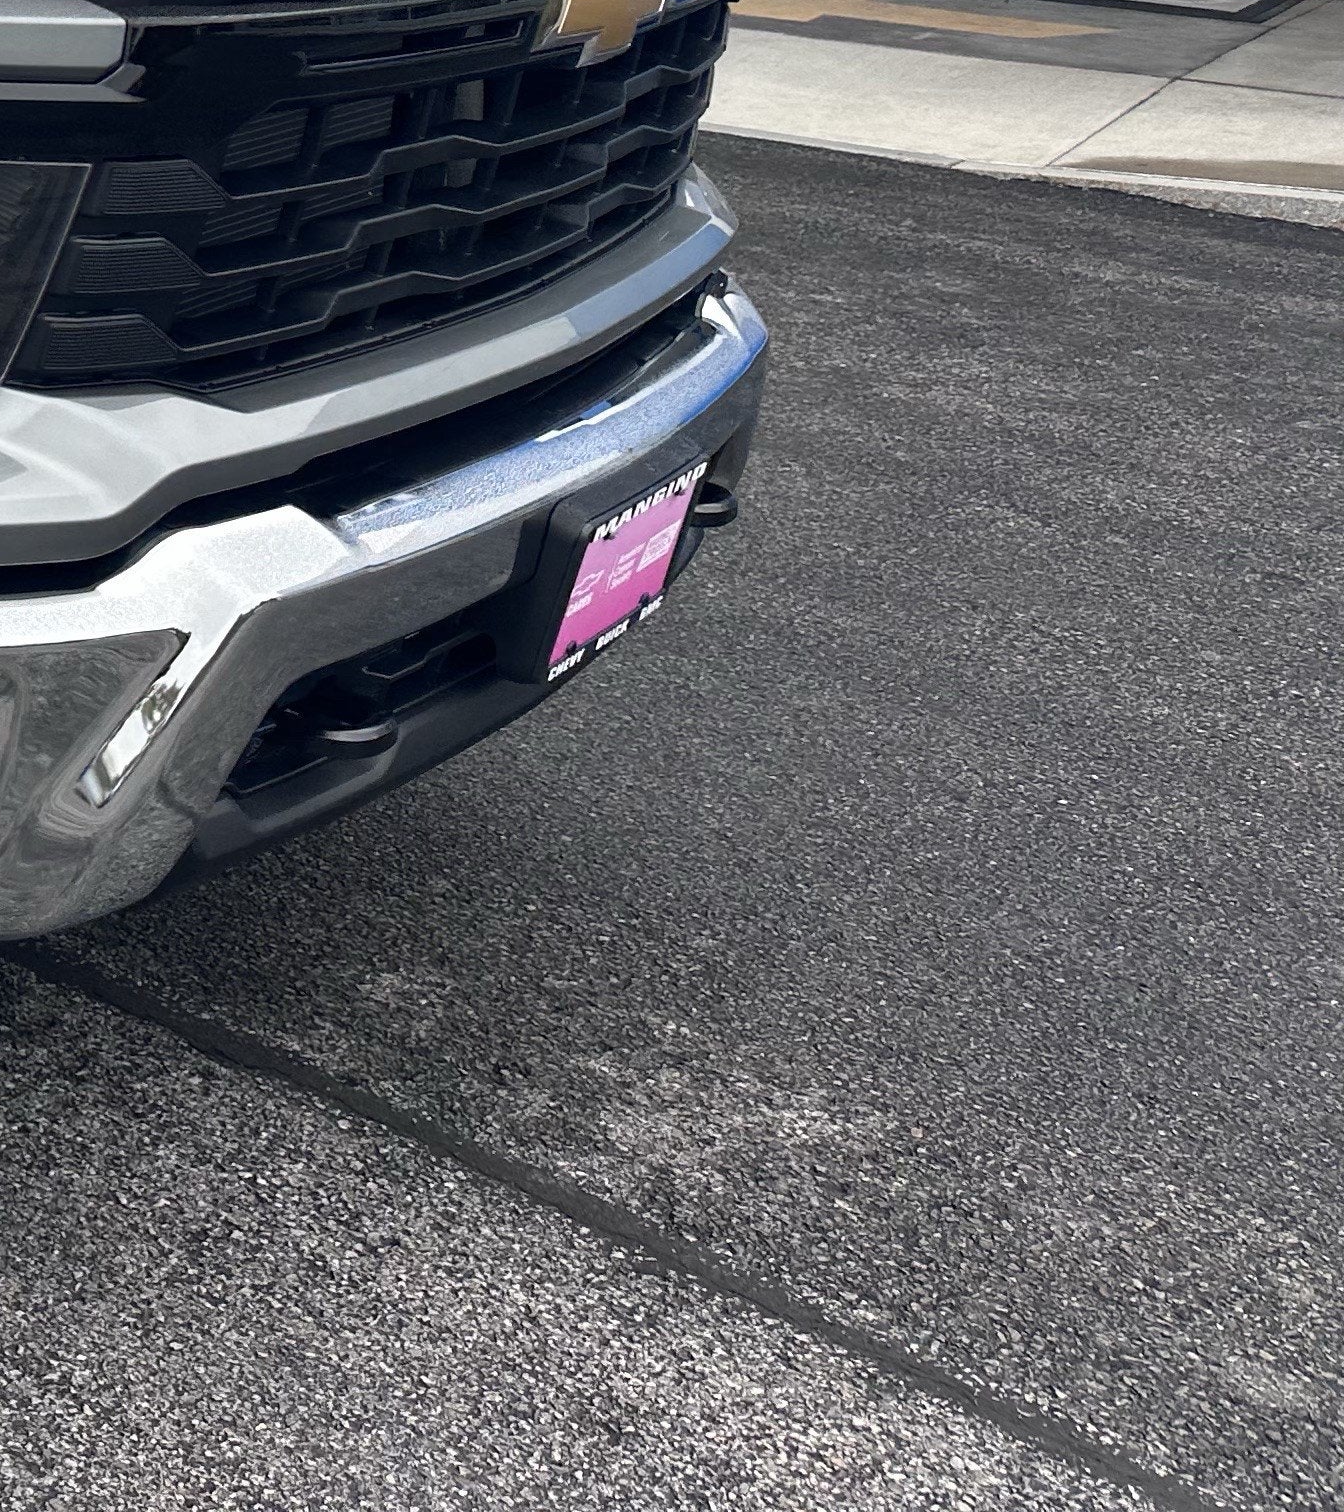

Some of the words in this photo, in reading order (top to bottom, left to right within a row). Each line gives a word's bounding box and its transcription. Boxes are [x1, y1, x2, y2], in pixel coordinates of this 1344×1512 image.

[593, 461, 708, 543] MANGINO
[547, 647, 586, 682] CHEVY
[595, 618, 630, 651] BUICK
